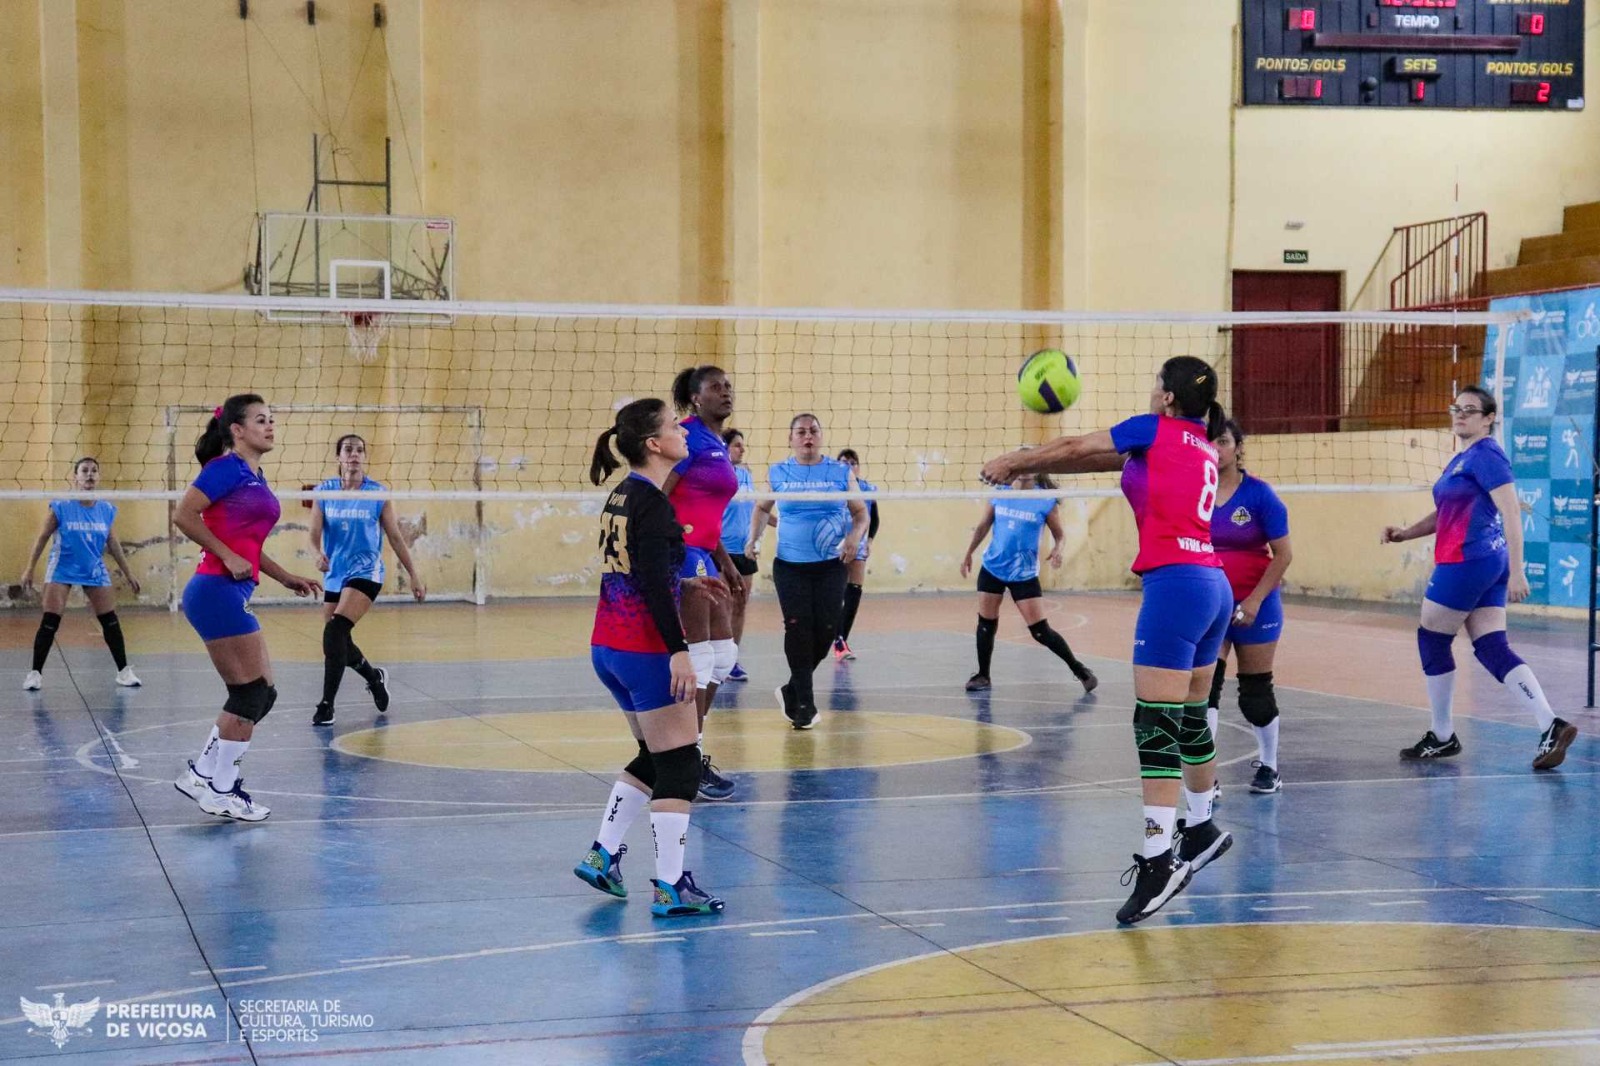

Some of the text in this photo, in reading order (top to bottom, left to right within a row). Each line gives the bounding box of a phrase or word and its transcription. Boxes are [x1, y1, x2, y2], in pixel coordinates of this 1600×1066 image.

[1301, 10, 1315, 29] 0
[1394, 14, 1440, 28] TEMPO
[1531, 13, 1544, 34] 0
[1256, 57, 1347, 72] PONTOS/GOLS
[1403, 58, 1437, 71] SETS
[1486, 61, 1574, 76] PONTOS/GOLS
[1536, 82, 1551, 103] 2
[1198, 460, 1218, 522] 8
